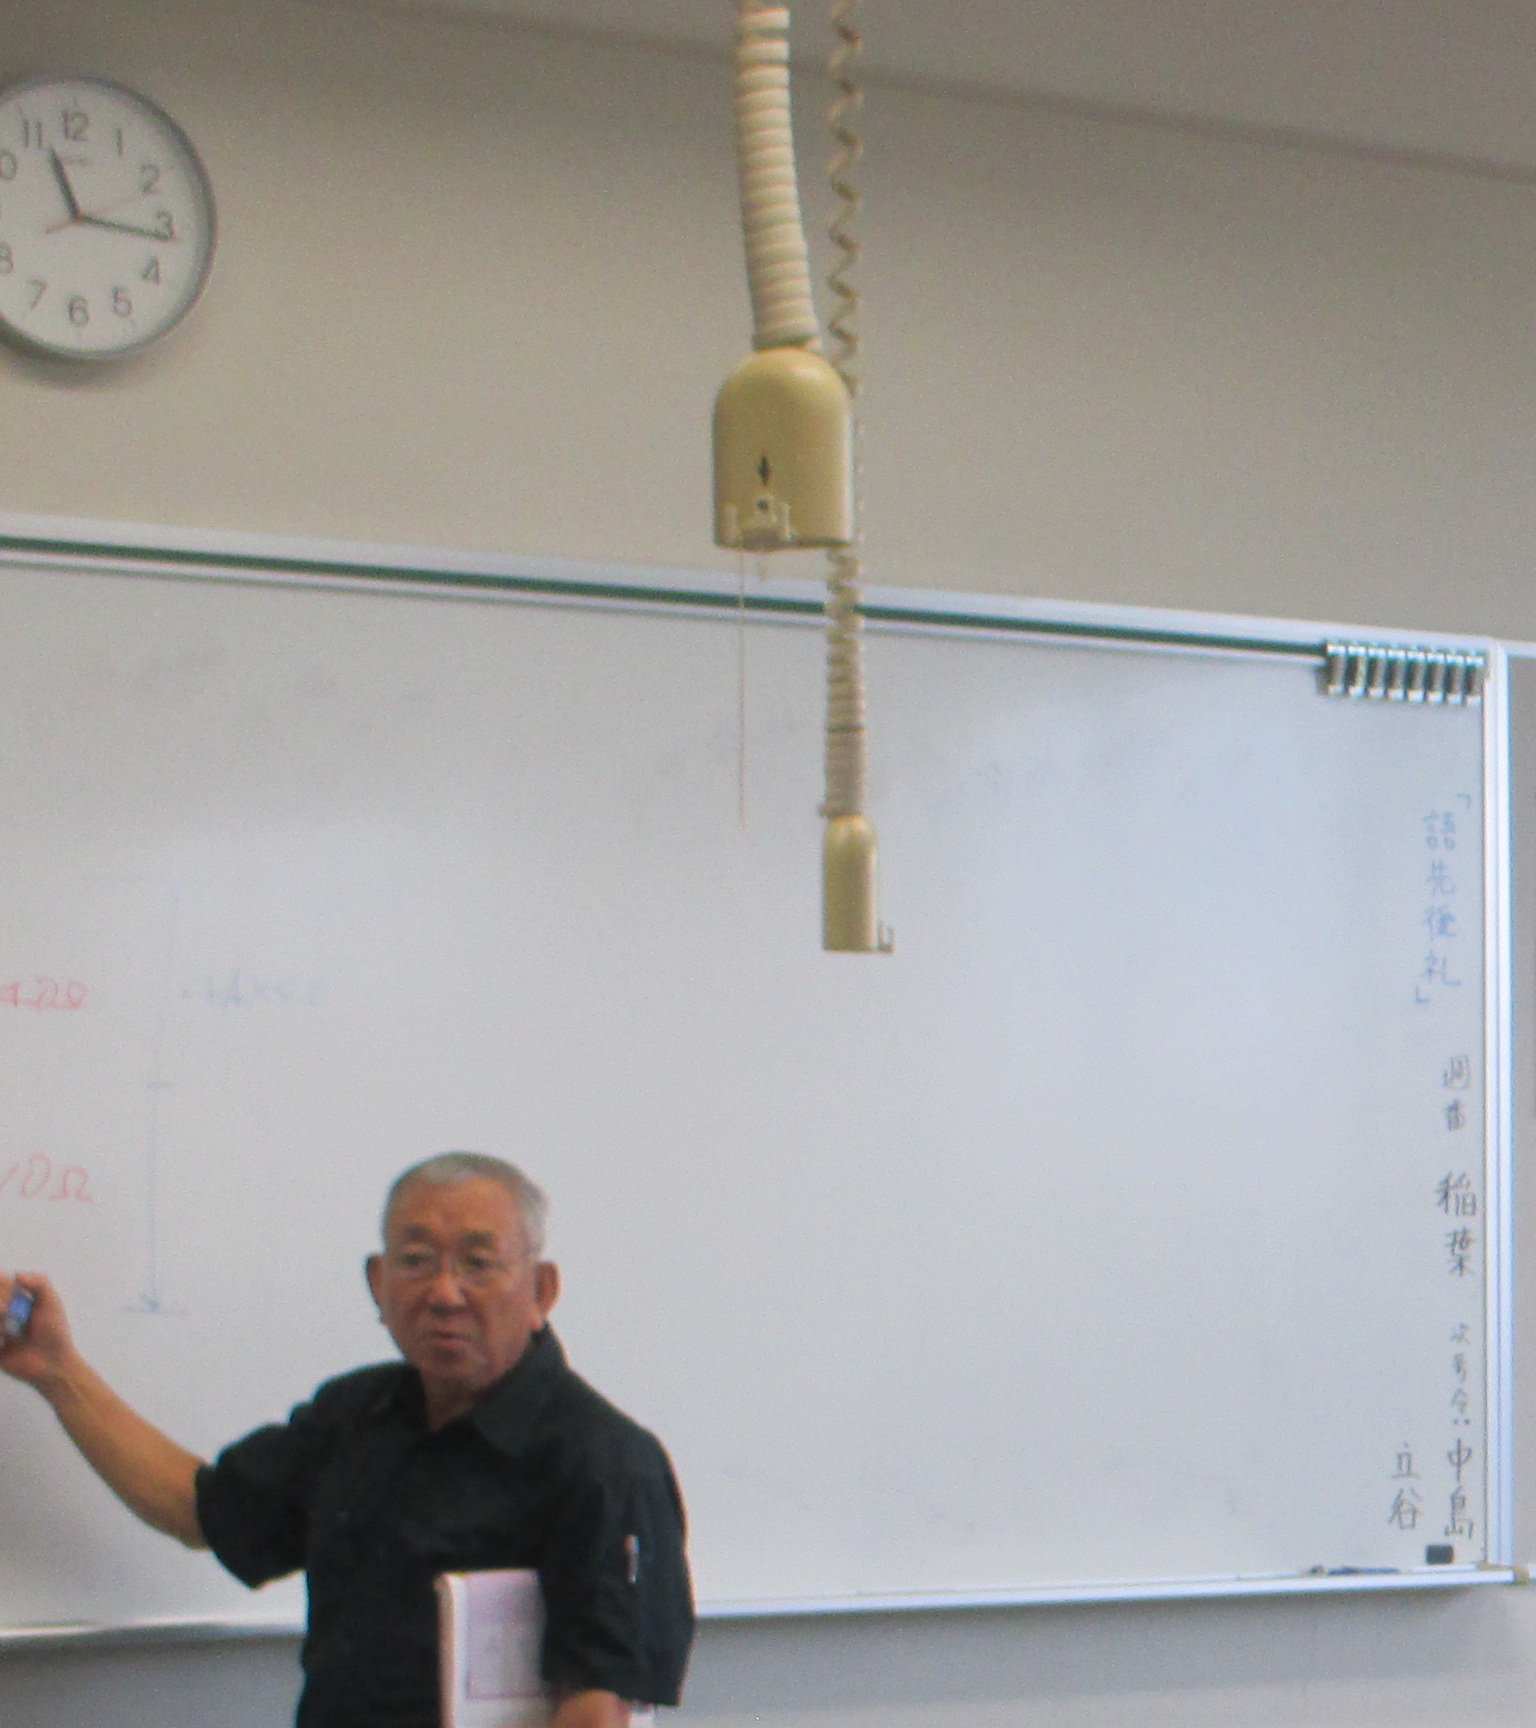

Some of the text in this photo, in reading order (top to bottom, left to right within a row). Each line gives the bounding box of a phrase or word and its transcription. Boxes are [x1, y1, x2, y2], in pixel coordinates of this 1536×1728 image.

[22, 118, 43, 149] 11
[62, 109, 89, 141] 12
[115, 126, 124, 157] 1
[139, 163, 160, 193] 2
[156, 210, 174, 238] 3
[141, 256, 161, 285] 4
[27, 278, 48, 312] 7
[68, 294, 90, 327] 6
[113, 285, 133, 318] 5
[1444, 1437, 1475, 1540] 中島
